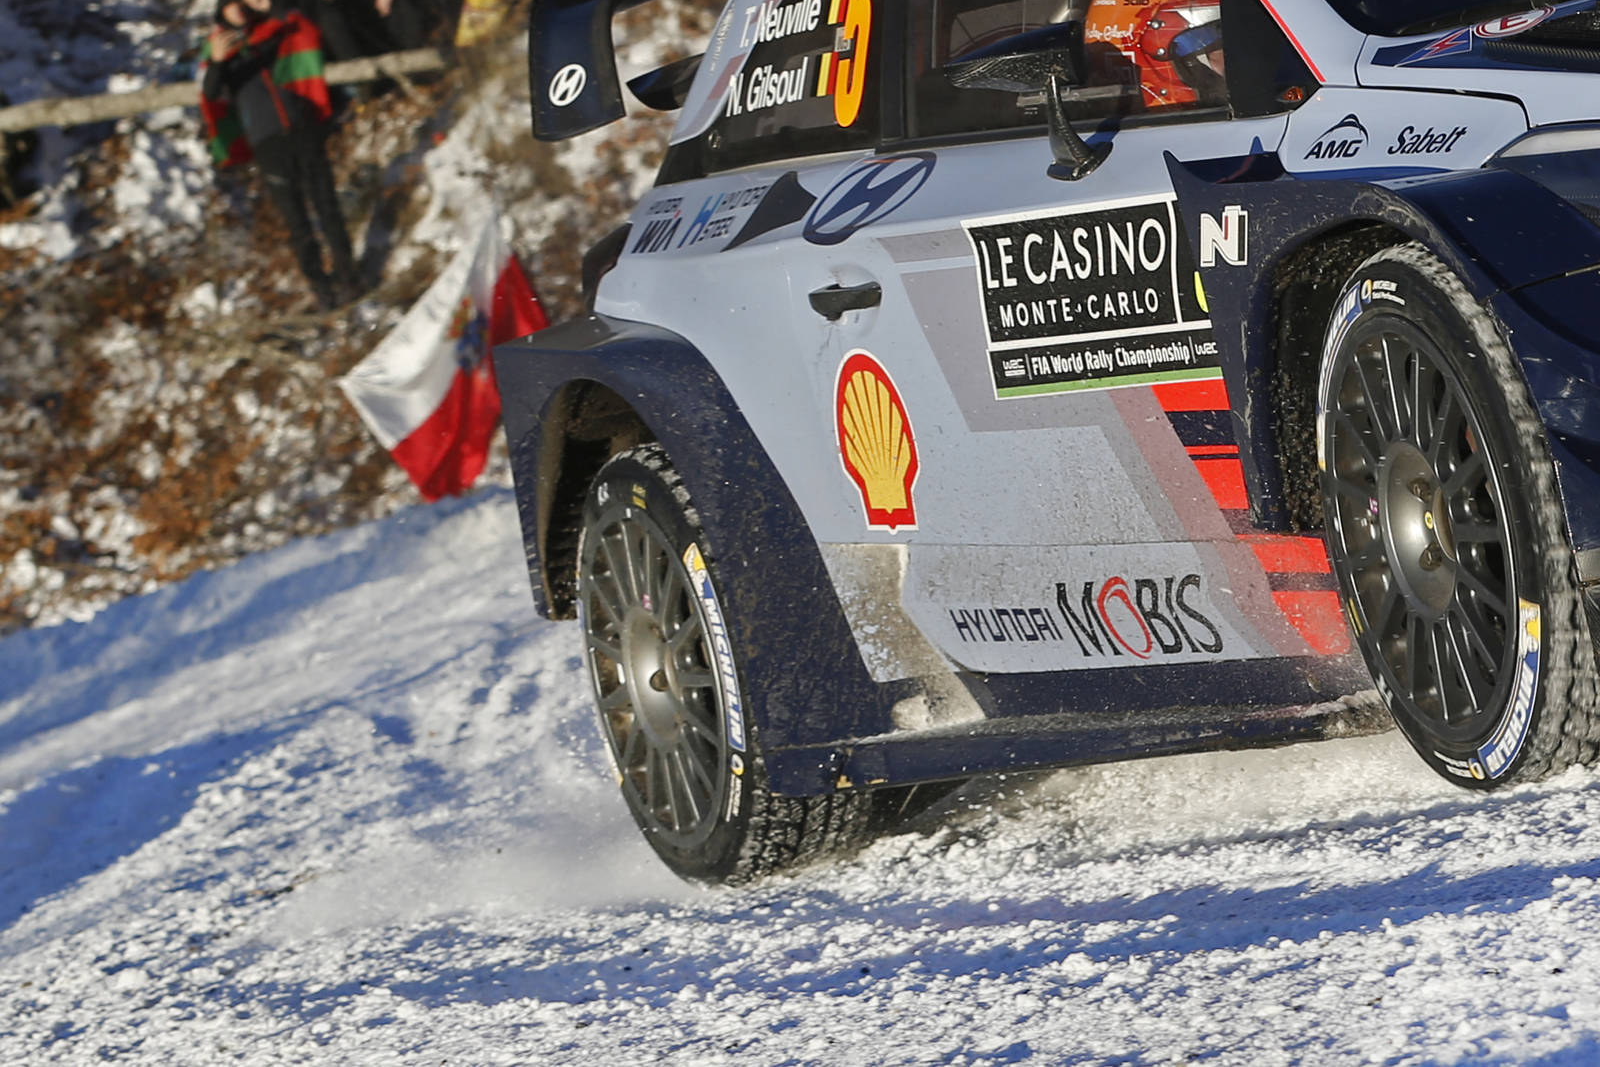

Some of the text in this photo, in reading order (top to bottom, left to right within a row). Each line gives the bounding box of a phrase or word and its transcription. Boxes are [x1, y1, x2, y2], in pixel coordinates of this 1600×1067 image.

[739, 5, 757, 49] T.
[725, 55, 809, 118] N. Gilsoul
[1303, 125, 1468, 160] AMG Sabelt
[980, 217, 1167, 290] LE CASINO
[1031, 357, 1052, 376] FIA
[1051, 349, 1084, 374] World
[1084, 345, 1114, 372] Rally
[1115, 339, 1191, 368] Championship
[949, 574, 1225, 660] HYUNDAI MOBIS
[702, 597, 744, 748] MICHELIN
